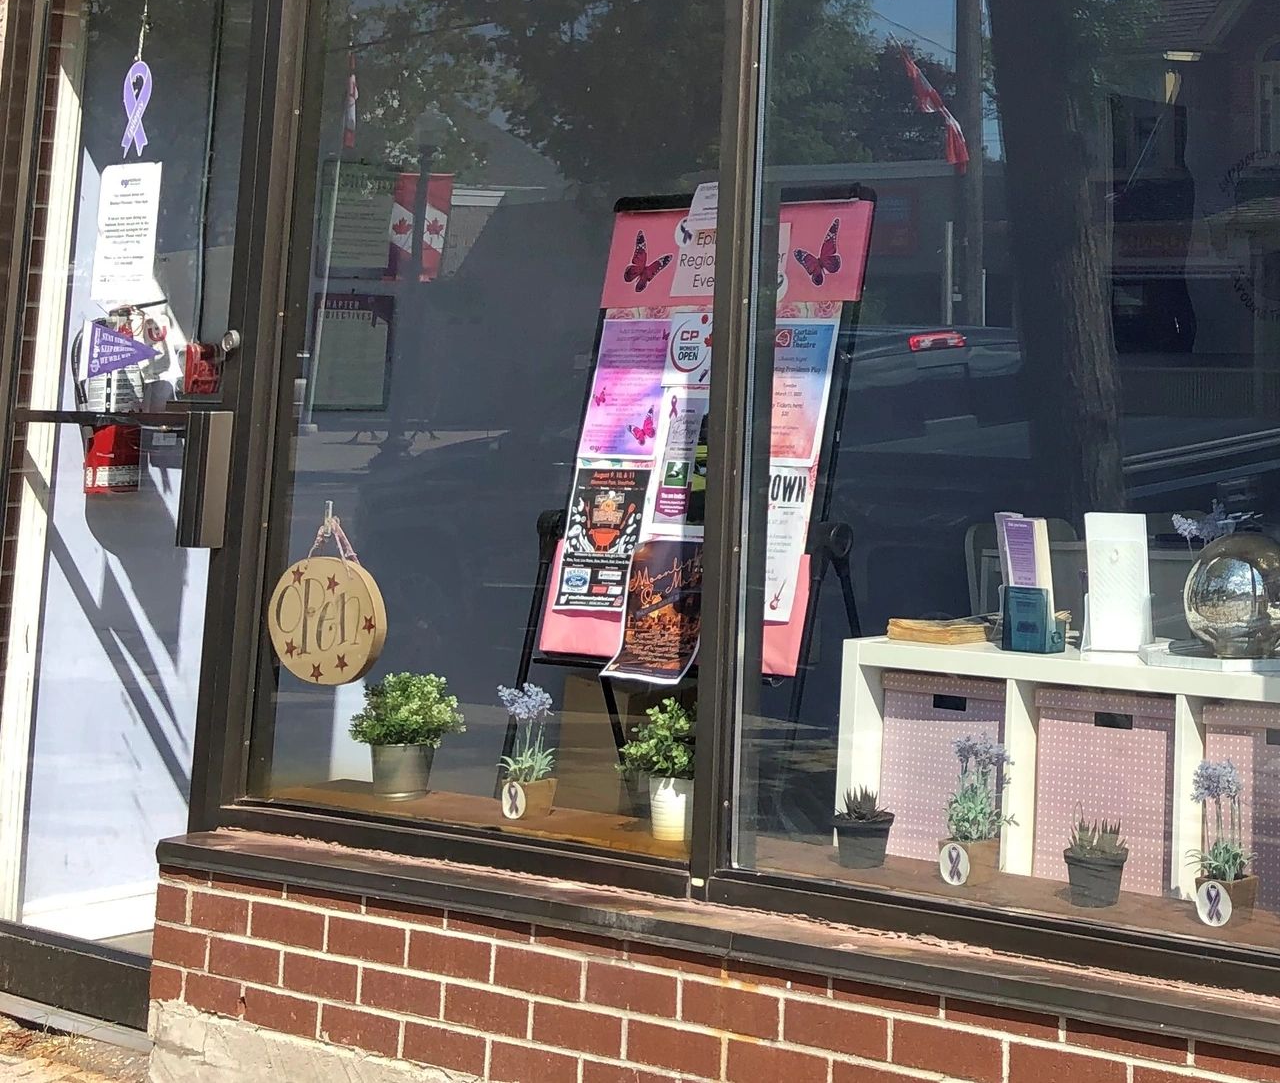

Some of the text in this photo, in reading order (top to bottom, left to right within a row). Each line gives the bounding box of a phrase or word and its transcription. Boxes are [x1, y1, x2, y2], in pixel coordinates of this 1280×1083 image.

[680, 253, 717, 270] Regio
[680, 330, 700, 341] CP
[678, 351, 699, 361] OPEN
[594, 472, 609, 480] August
